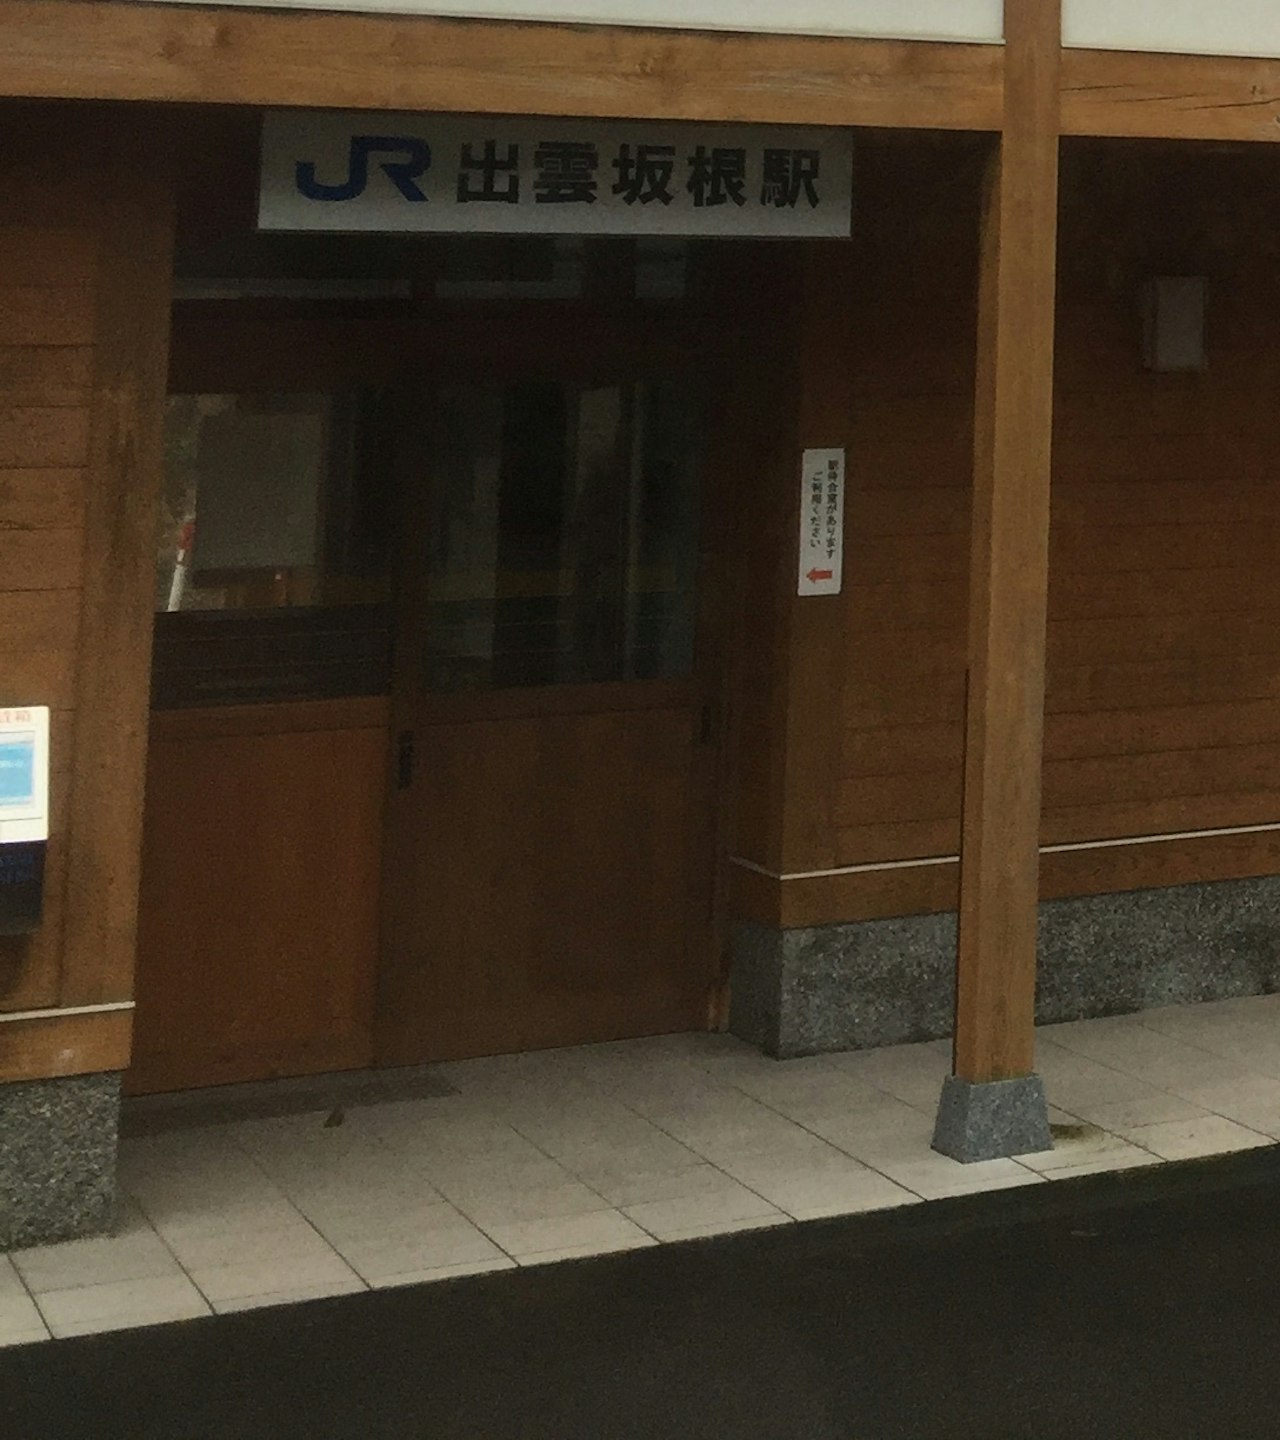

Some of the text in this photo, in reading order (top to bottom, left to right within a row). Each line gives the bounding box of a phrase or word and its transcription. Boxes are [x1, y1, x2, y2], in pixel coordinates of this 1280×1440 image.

[295, 135, 821, 208] JR 出雲坂根駅
